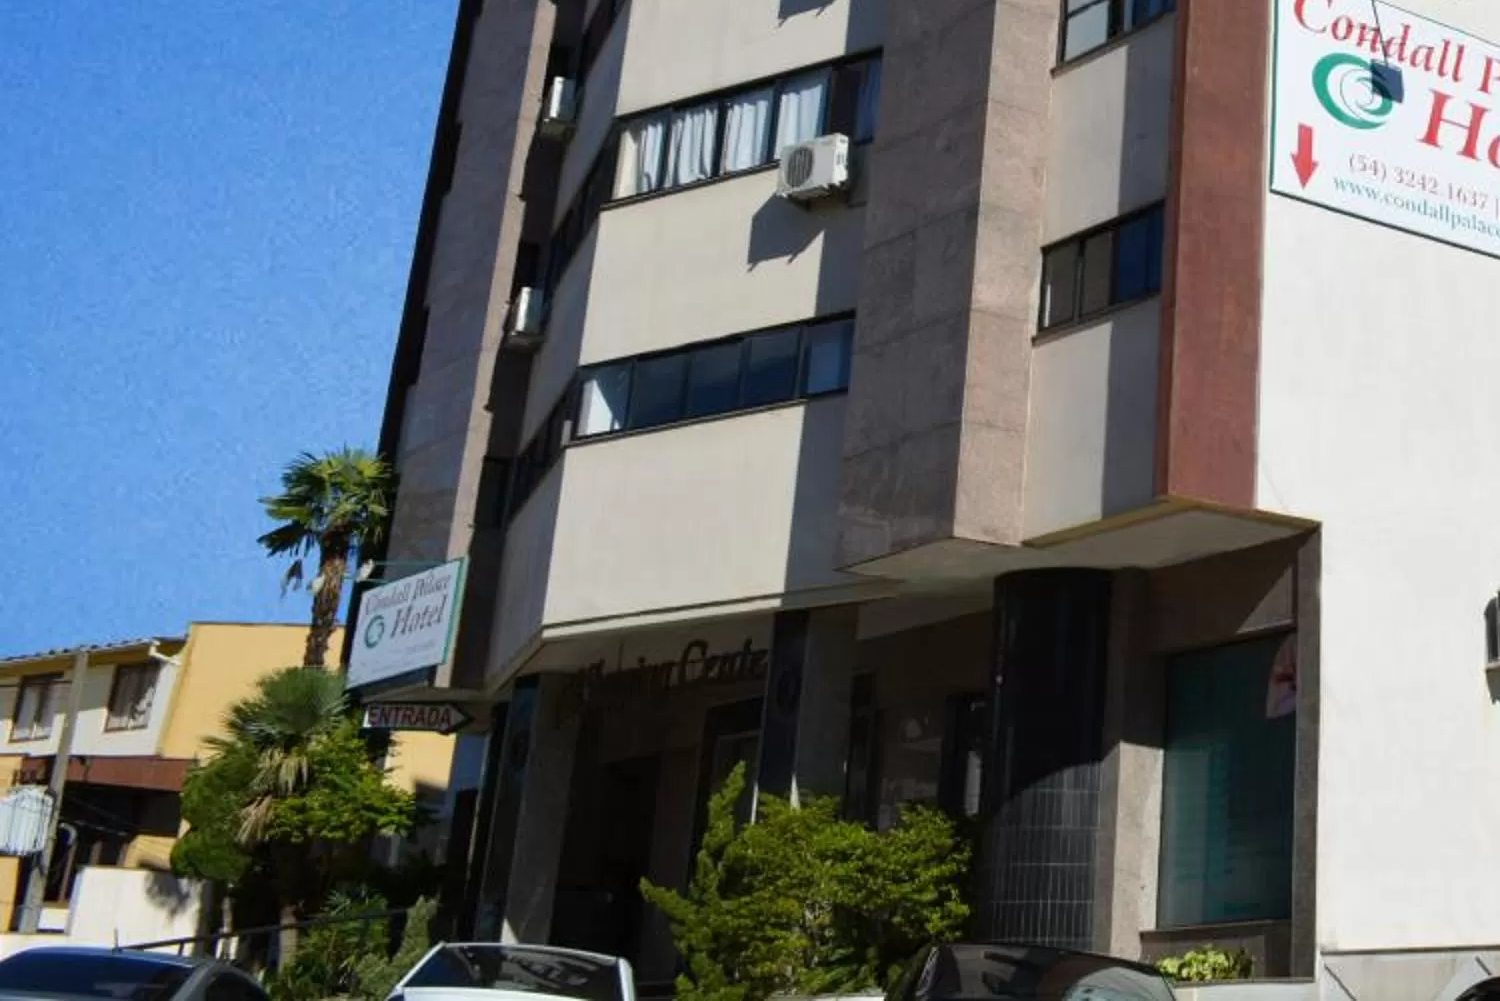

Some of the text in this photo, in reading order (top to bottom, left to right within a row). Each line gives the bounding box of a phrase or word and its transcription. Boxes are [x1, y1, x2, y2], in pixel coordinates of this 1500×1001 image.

[1348, 152, 1387, 183] (54)
[390, 594, 448, 639] Hotel
[369, 705, 452, 728] ENTRADA
